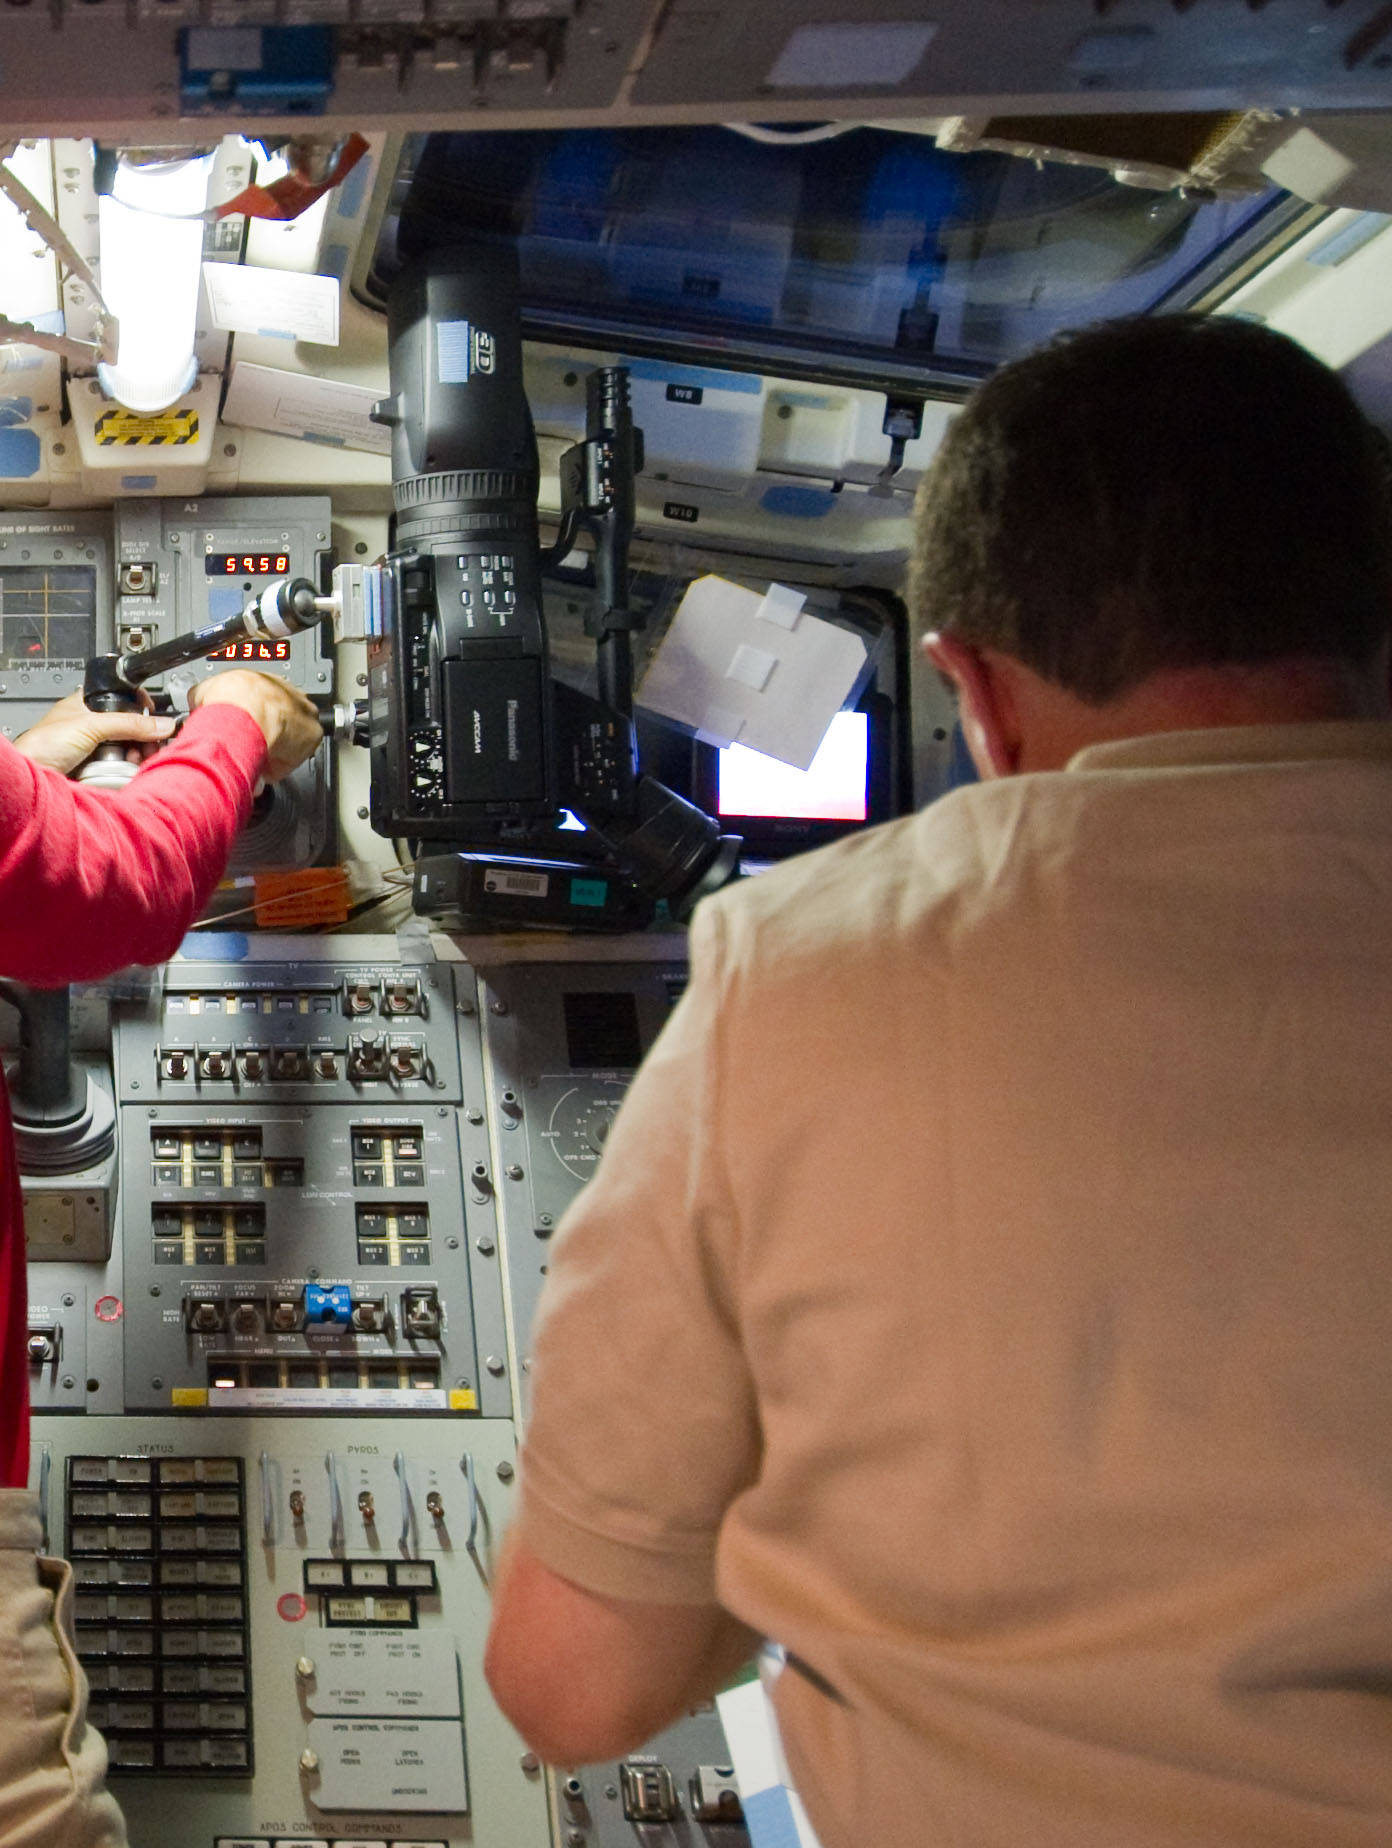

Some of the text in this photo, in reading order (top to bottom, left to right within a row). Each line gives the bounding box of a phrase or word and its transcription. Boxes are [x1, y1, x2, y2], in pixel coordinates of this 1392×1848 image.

[184, 504, 199, 512] A2
[508, 699, 519, 761] Panasonic
[137, 1445, 174, 1453] STATUS
[347, 1446, 379, 1454] PYROS
